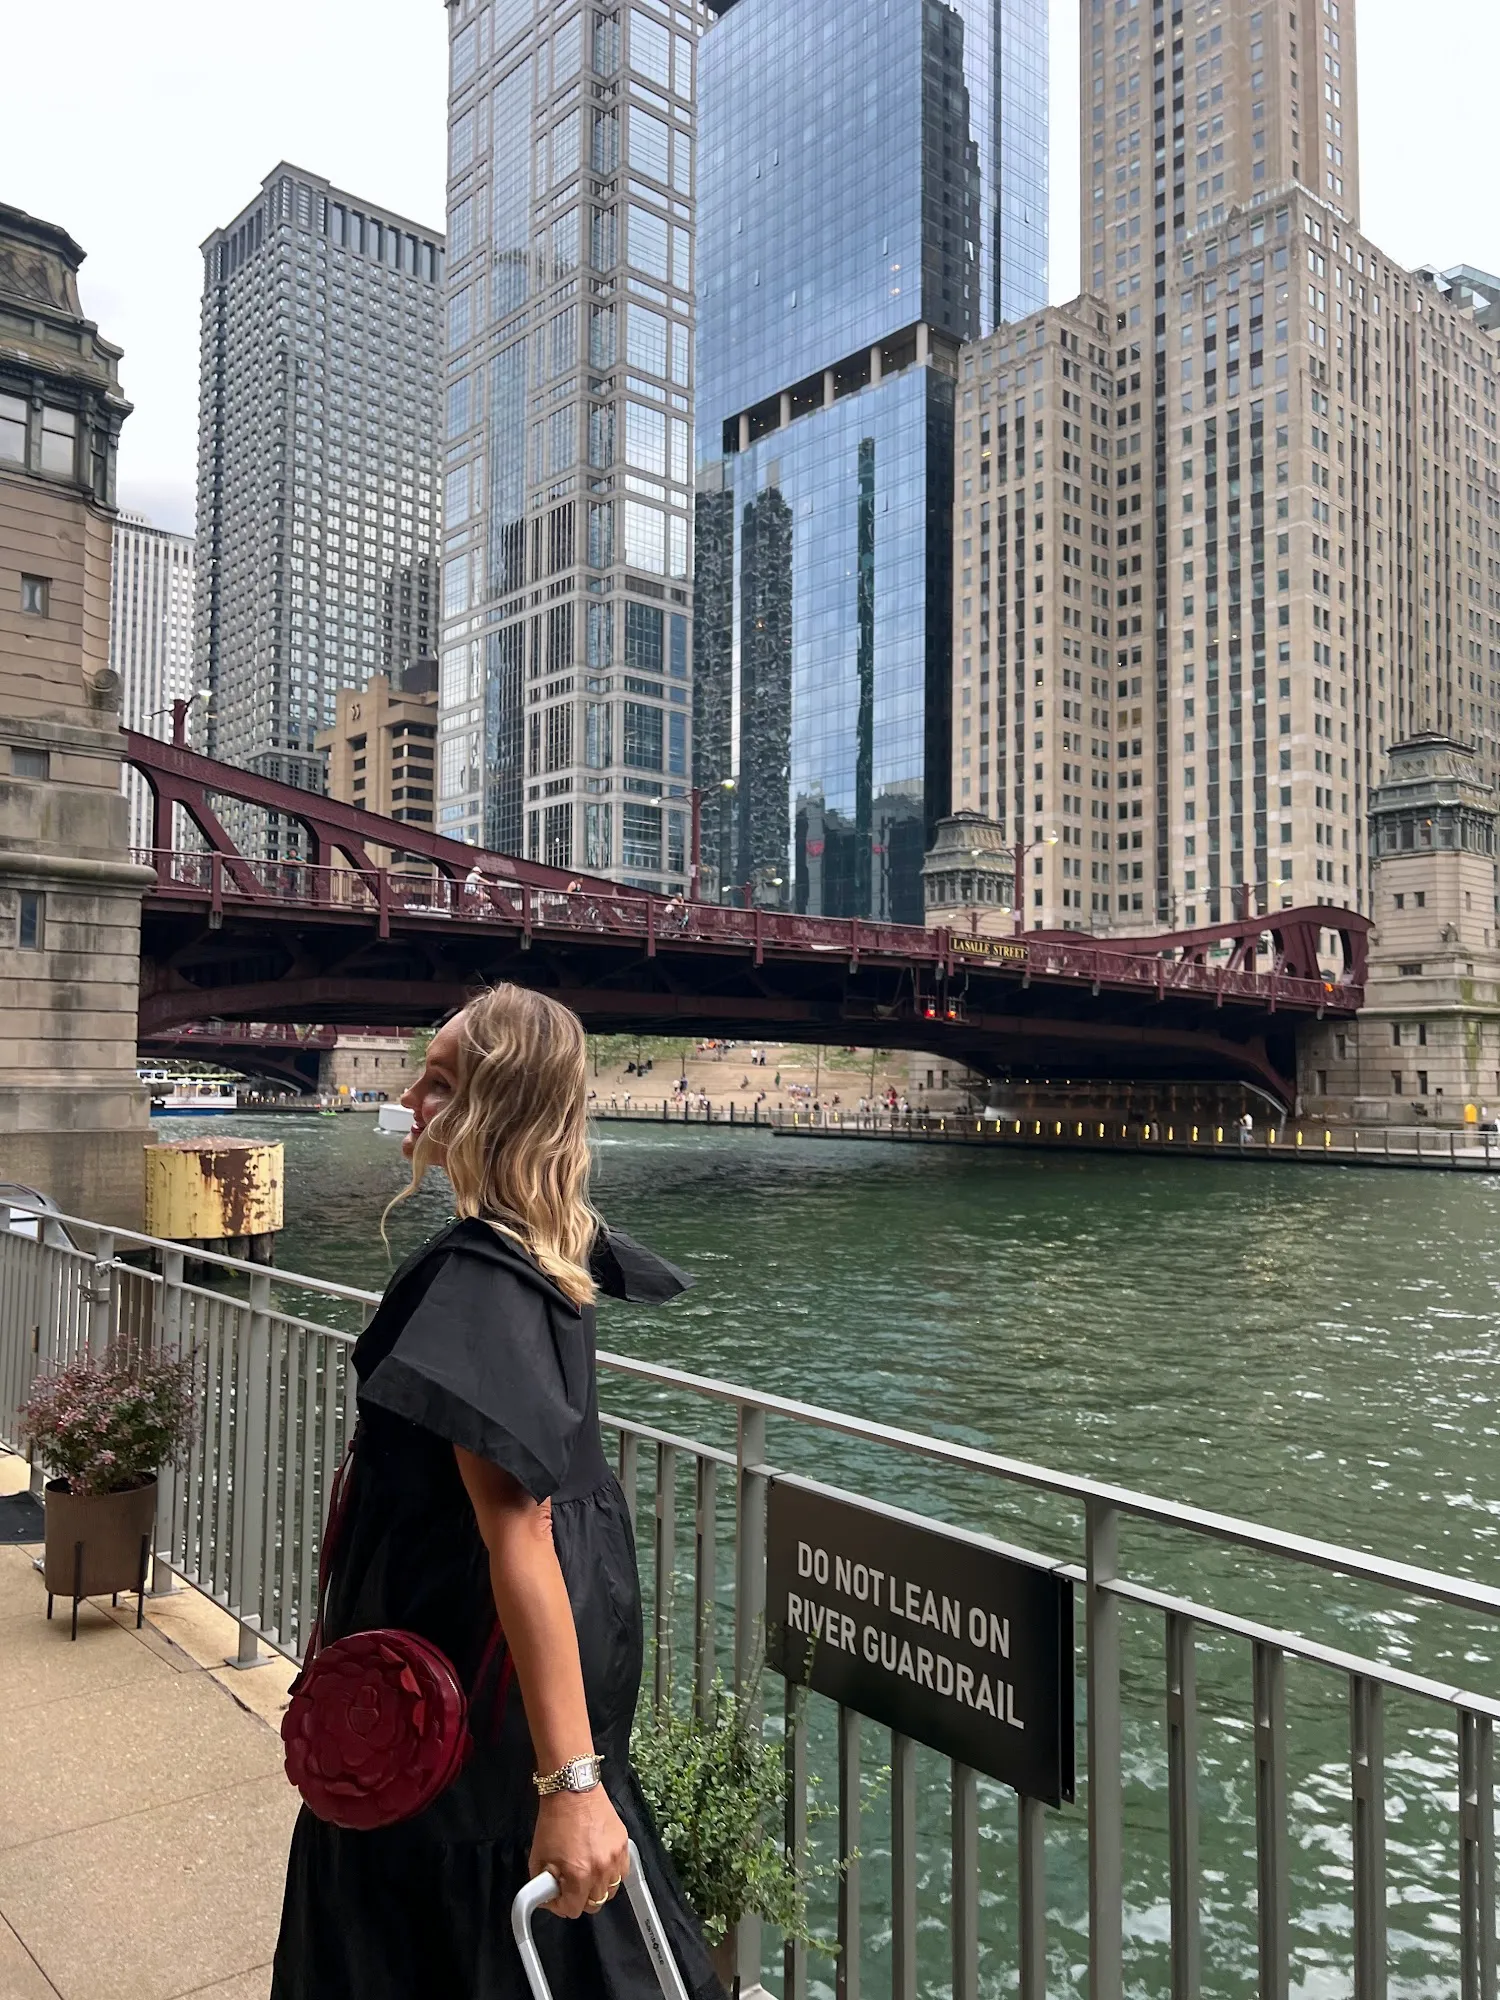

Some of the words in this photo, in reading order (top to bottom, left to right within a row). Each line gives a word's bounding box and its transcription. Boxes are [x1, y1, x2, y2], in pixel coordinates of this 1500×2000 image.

[993, 944, 1025, 959] STREET
[798, 1541, 829, 1585] DO
[835, 1555, 885, 1607] NOT
[889, 1575, 960, 1640] LEAN
[968, 1607, 1010, 1659] ON
[788, 1591, 857, 1656] RIVER
[863, 1625, 1025, 1730] GUARDRAIL
